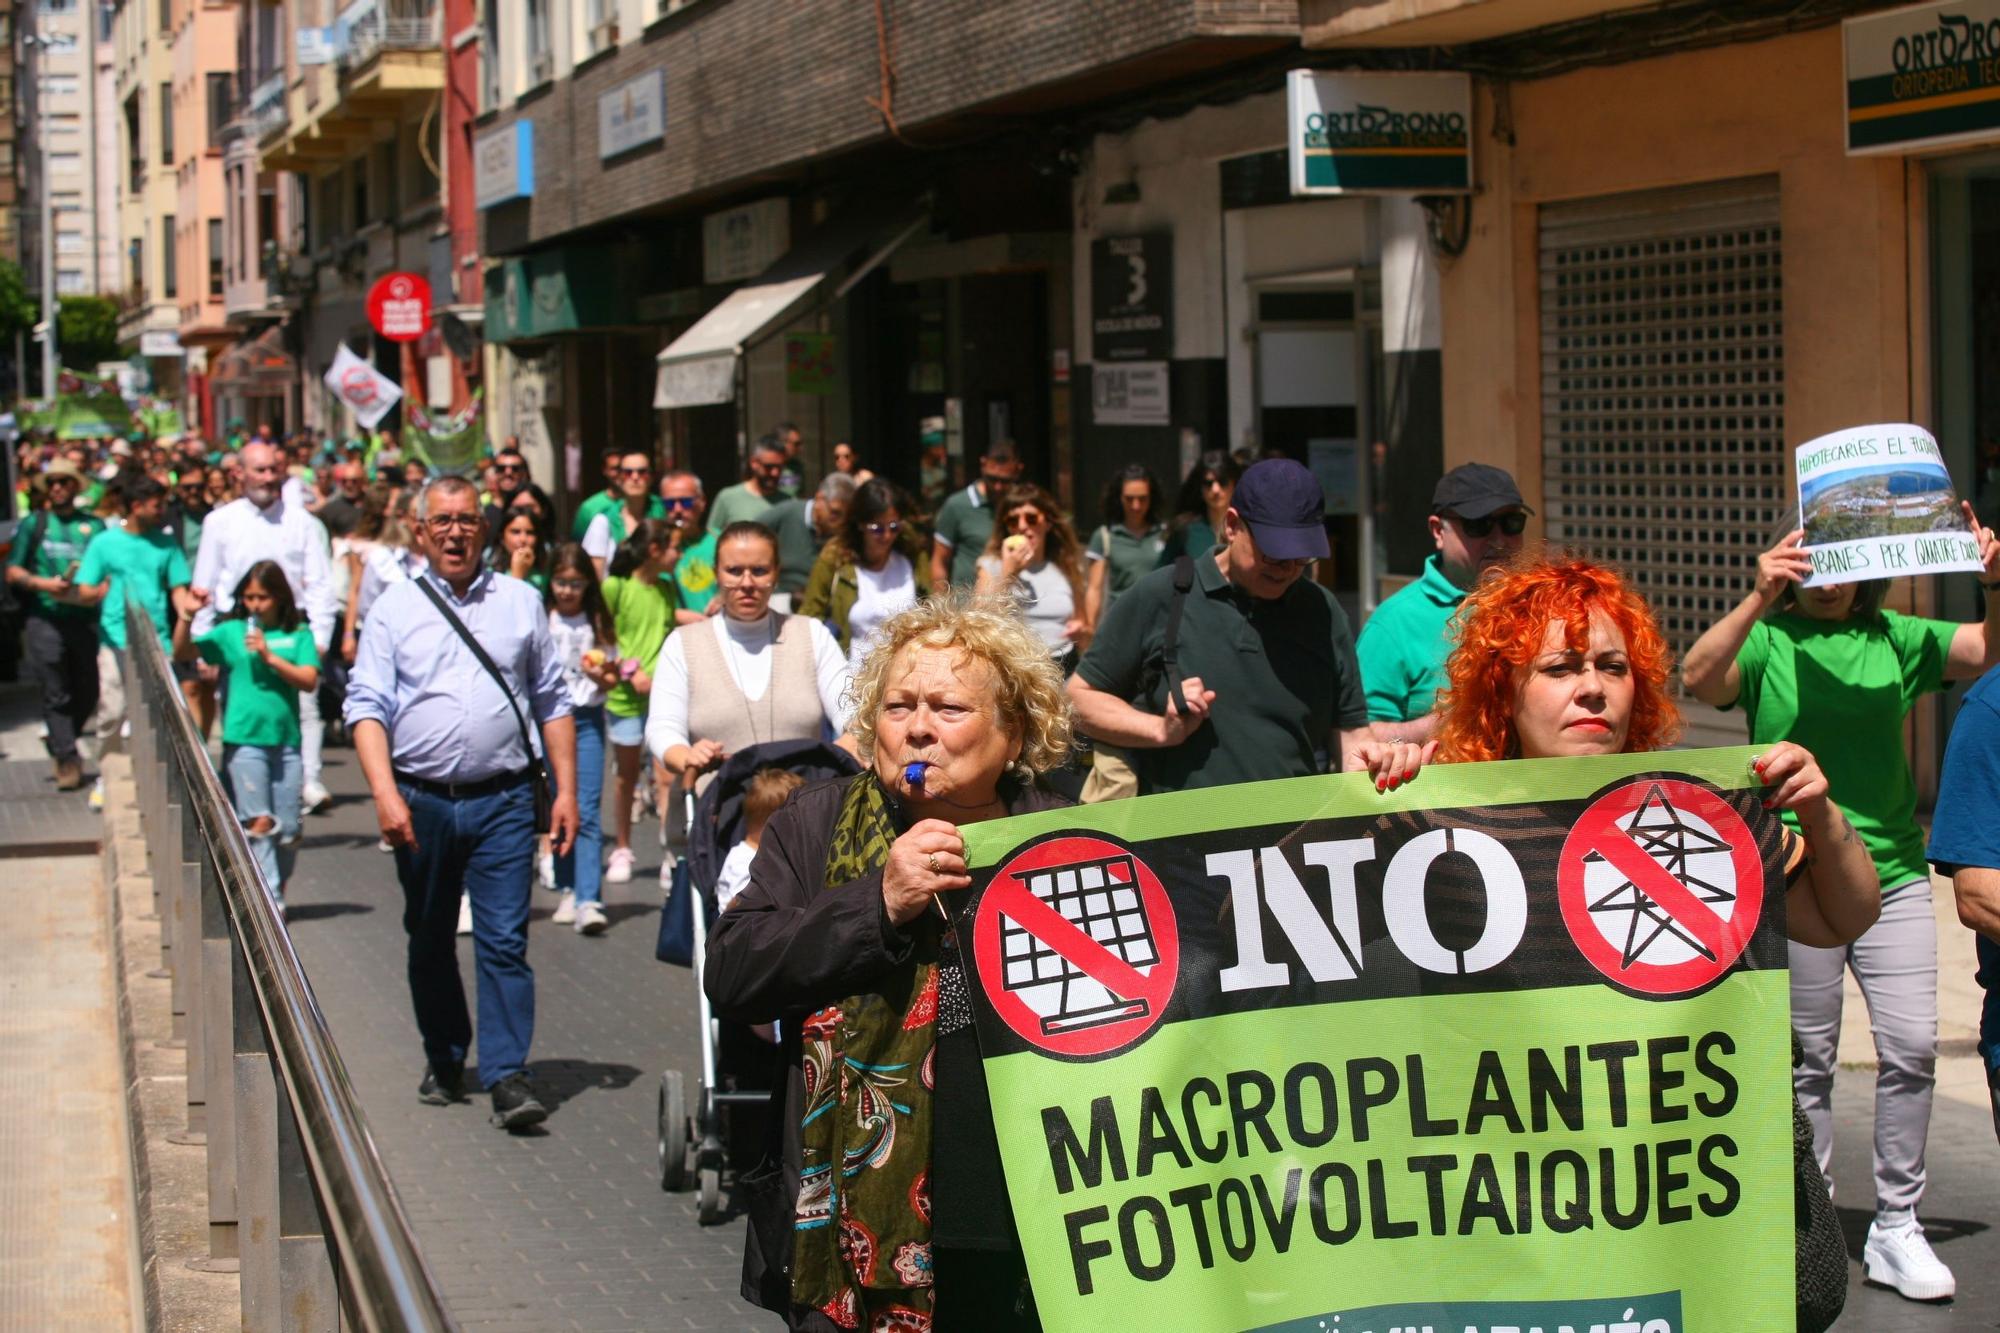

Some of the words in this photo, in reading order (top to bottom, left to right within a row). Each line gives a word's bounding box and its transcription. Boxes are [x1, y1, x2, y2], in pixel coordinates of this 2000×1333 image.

[1892, 65, 1968, 99] ORTOPEDIA
[1127, 256, 1147, 305] 3
[1887, 436, 1907, 456] EL
[1805, 544, 1870, 576] ABANES
[1879, 543, 1909, 569] PER
[1914, 536, 1958, 567] QUATRE
[1205, 828, 1527, 992] NO
[1041, 1031, 1739, 1194] MACROPLANTES
[1064, 1134, 1741, 1296] FOTOVOLTAIQUES
